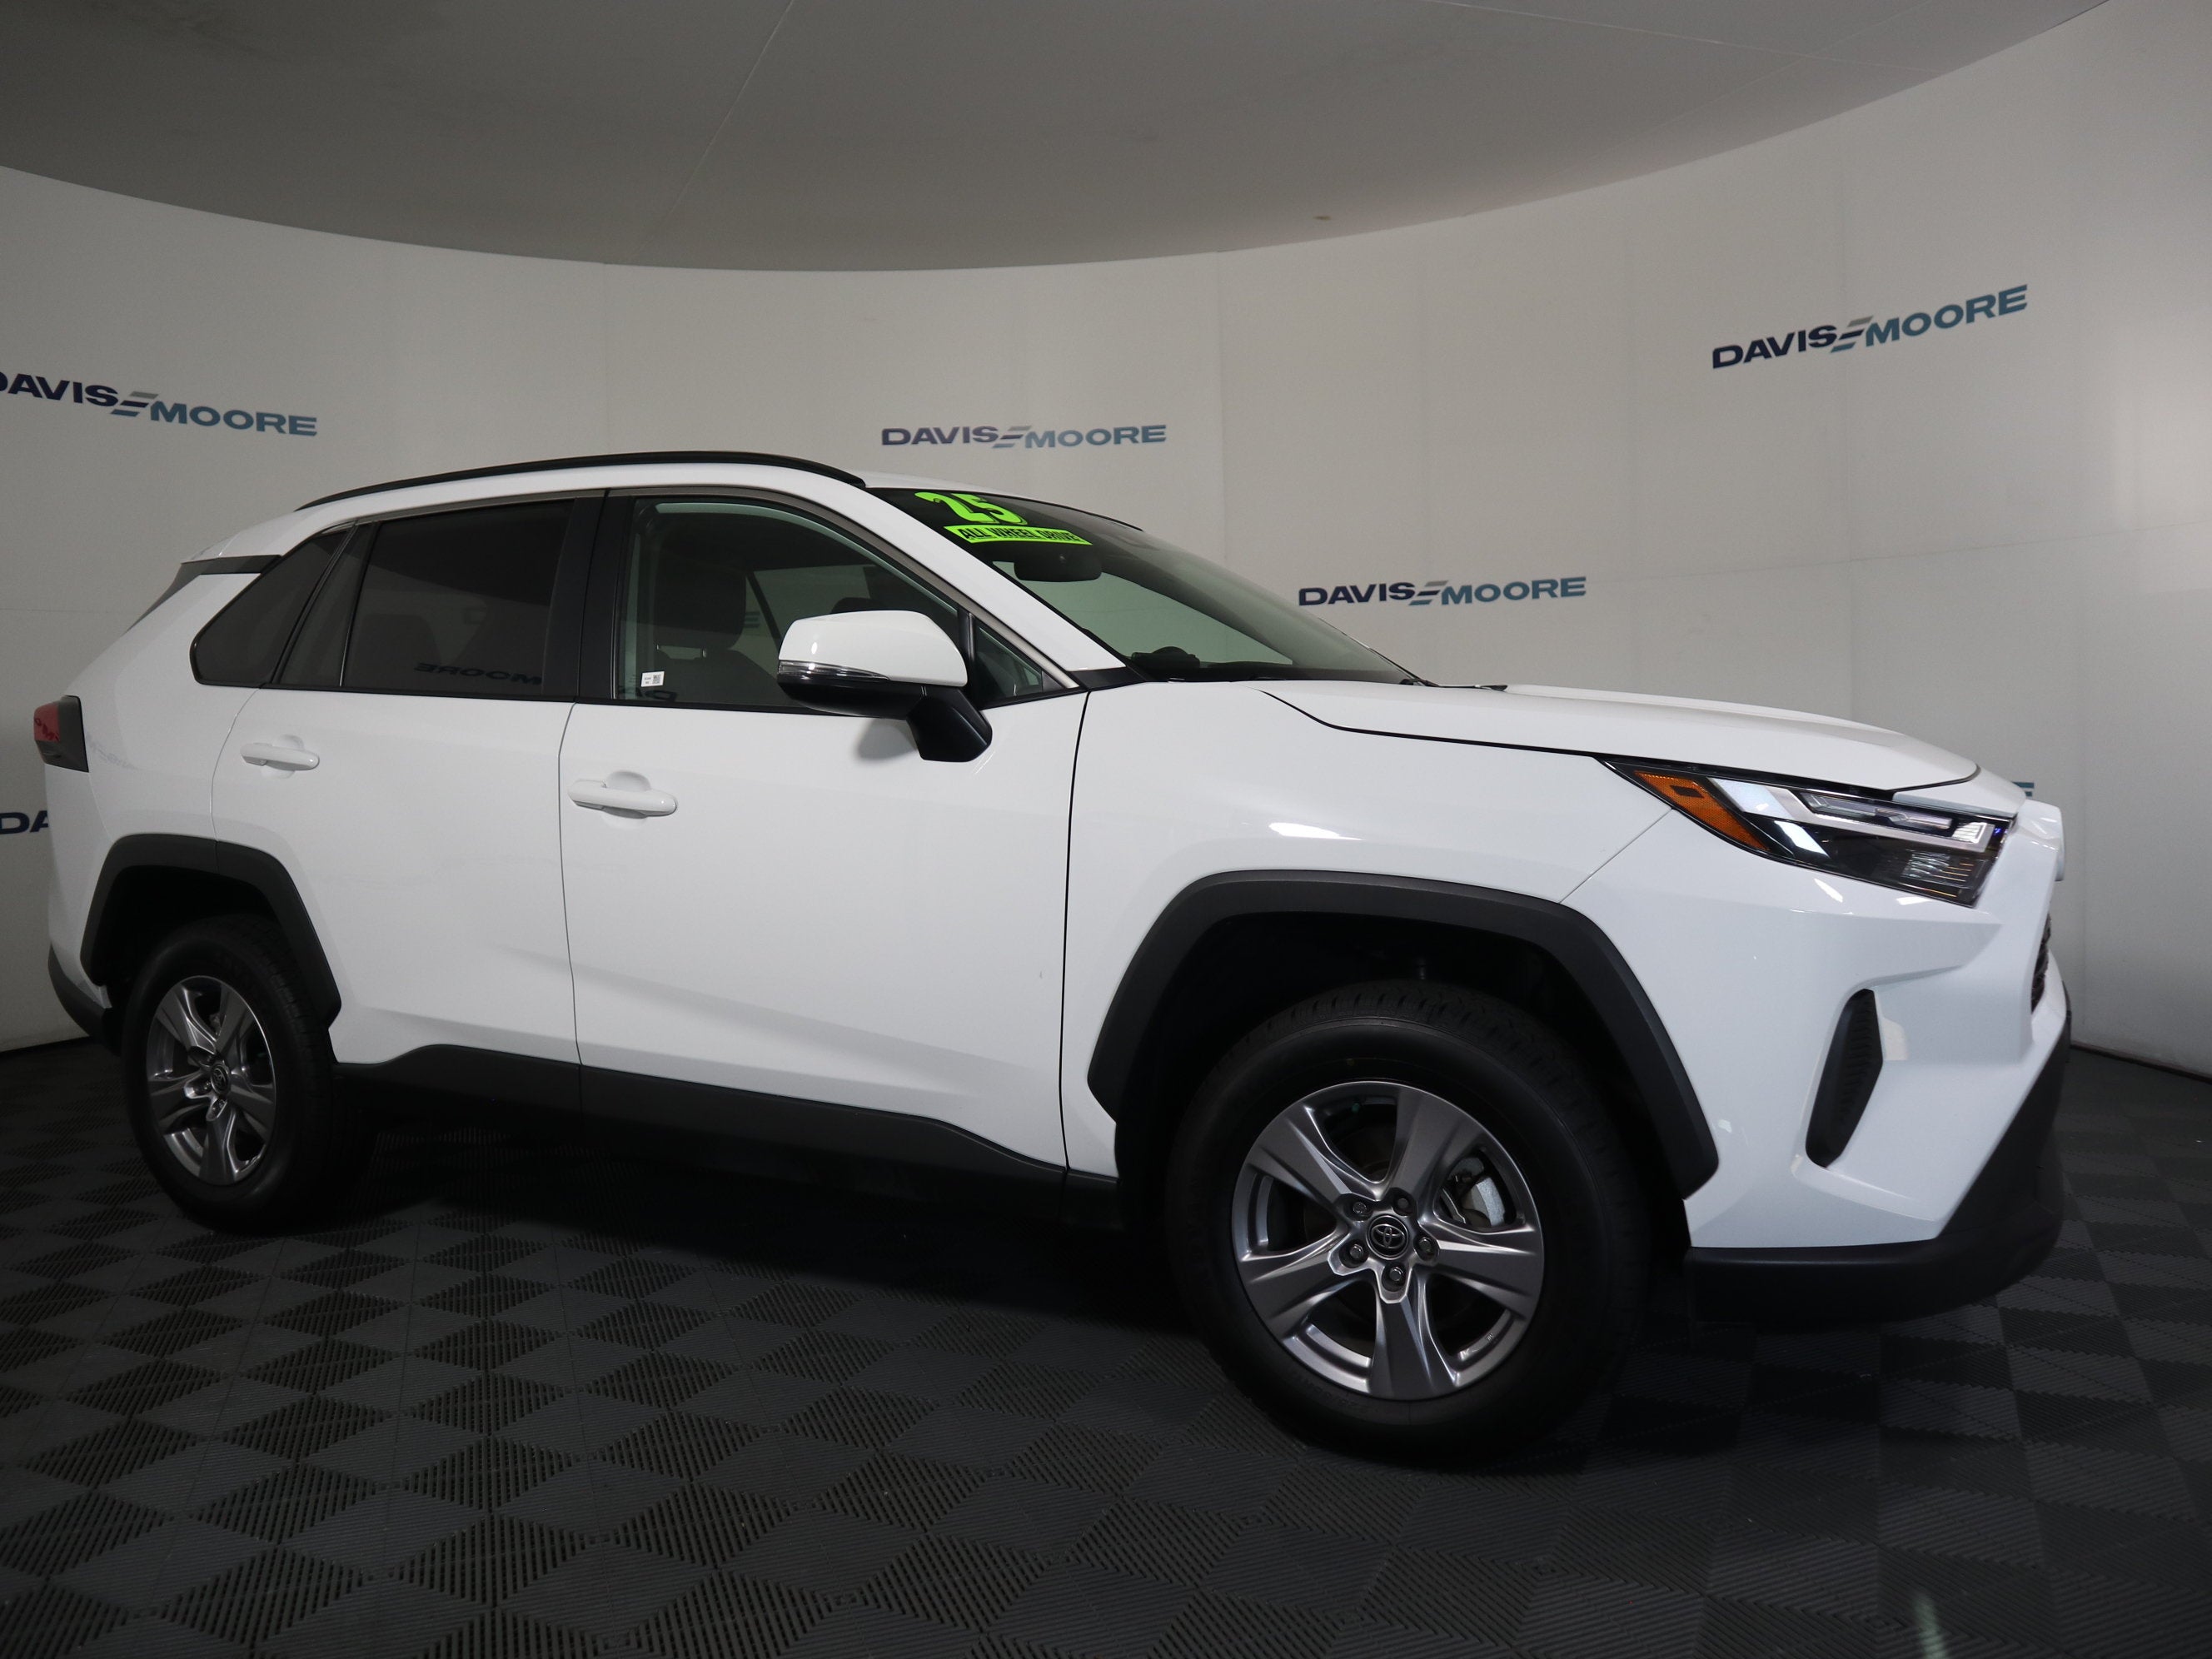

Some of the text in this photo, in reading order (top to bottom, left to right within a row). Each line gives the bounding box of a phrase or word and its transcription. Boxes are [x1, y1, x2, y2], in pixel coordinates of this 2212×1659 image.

[1713, 284, 2028, 369] DAVIS MOORE
[0, 371, 317, 436] AVIS MOORE
[881, 425, 1167, 449] DAVIS MOORE
[914, 491, 1028, 526] 25
[959, 527, 1080, 541] ALL WHEEL DRIVE
[1298, 576, 1587, 605] DAVIS MOORE
